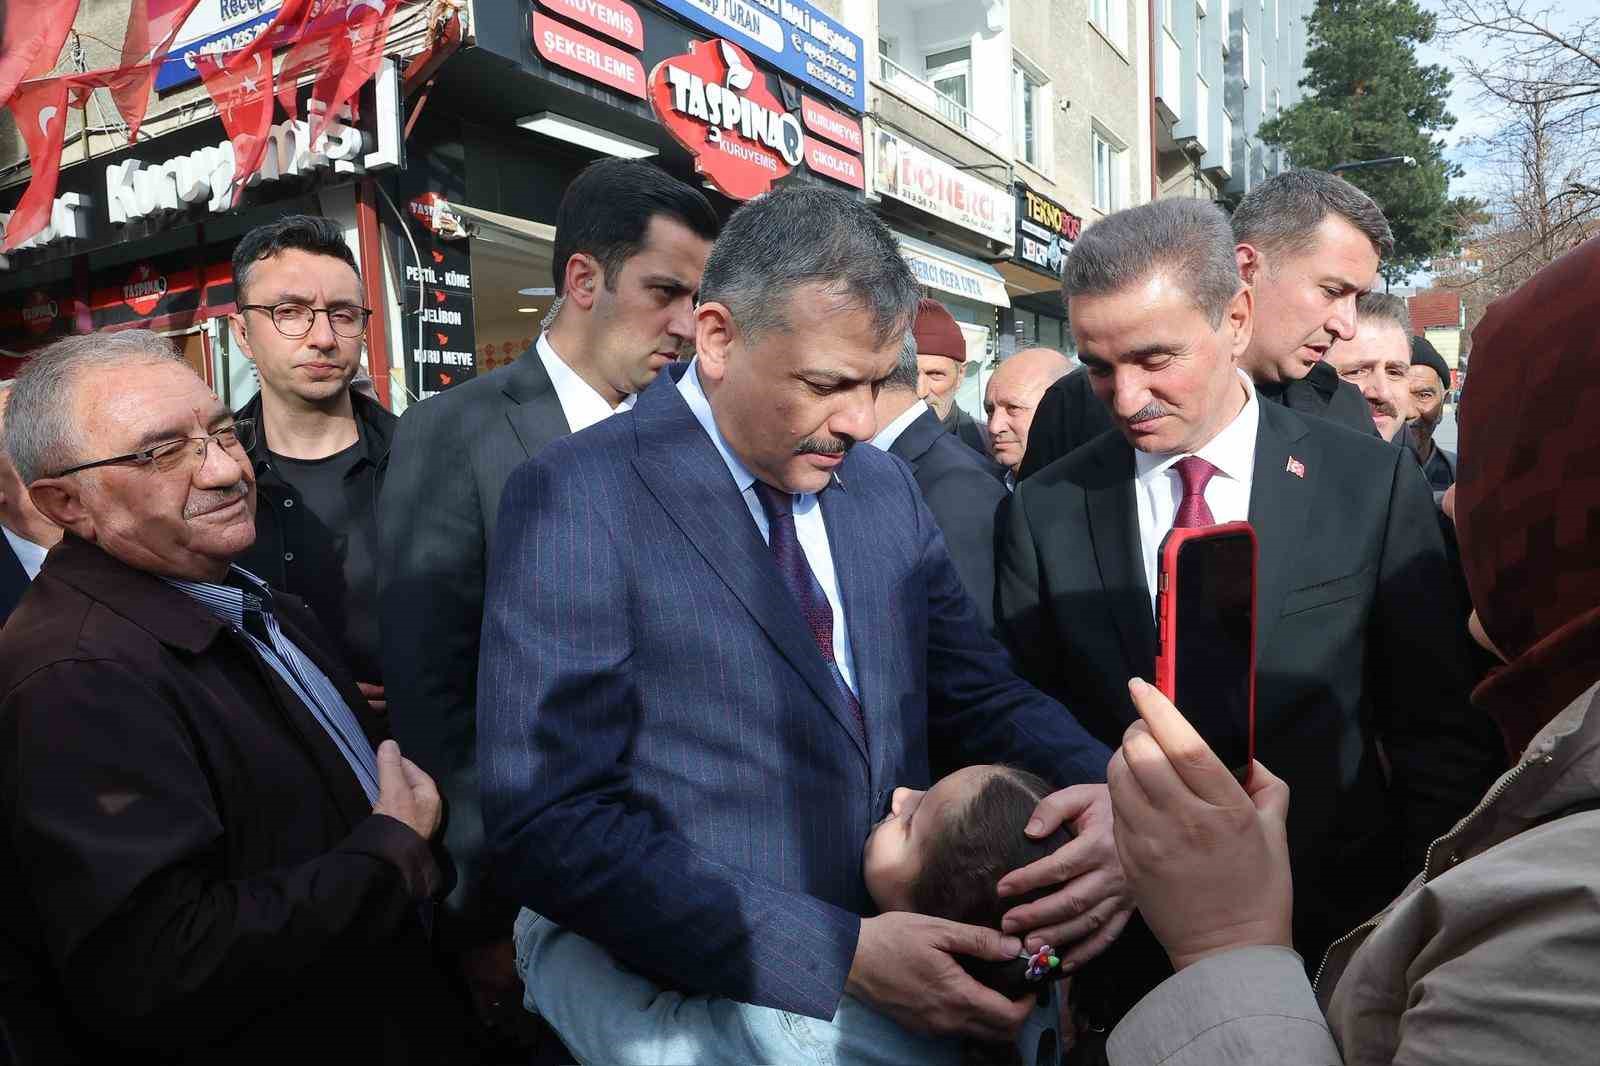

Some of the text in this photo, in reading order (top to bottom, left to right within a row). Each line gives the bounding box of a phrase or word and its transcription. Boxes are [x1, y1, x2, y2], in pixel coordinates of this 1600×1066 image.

[543, 30, 635, 83] ŞEKERLEME
[445, 270, 470, 288] KÖME
[422, 307, 461, 325] JELİBON
[442, 350, 473, 366] MEYVE
